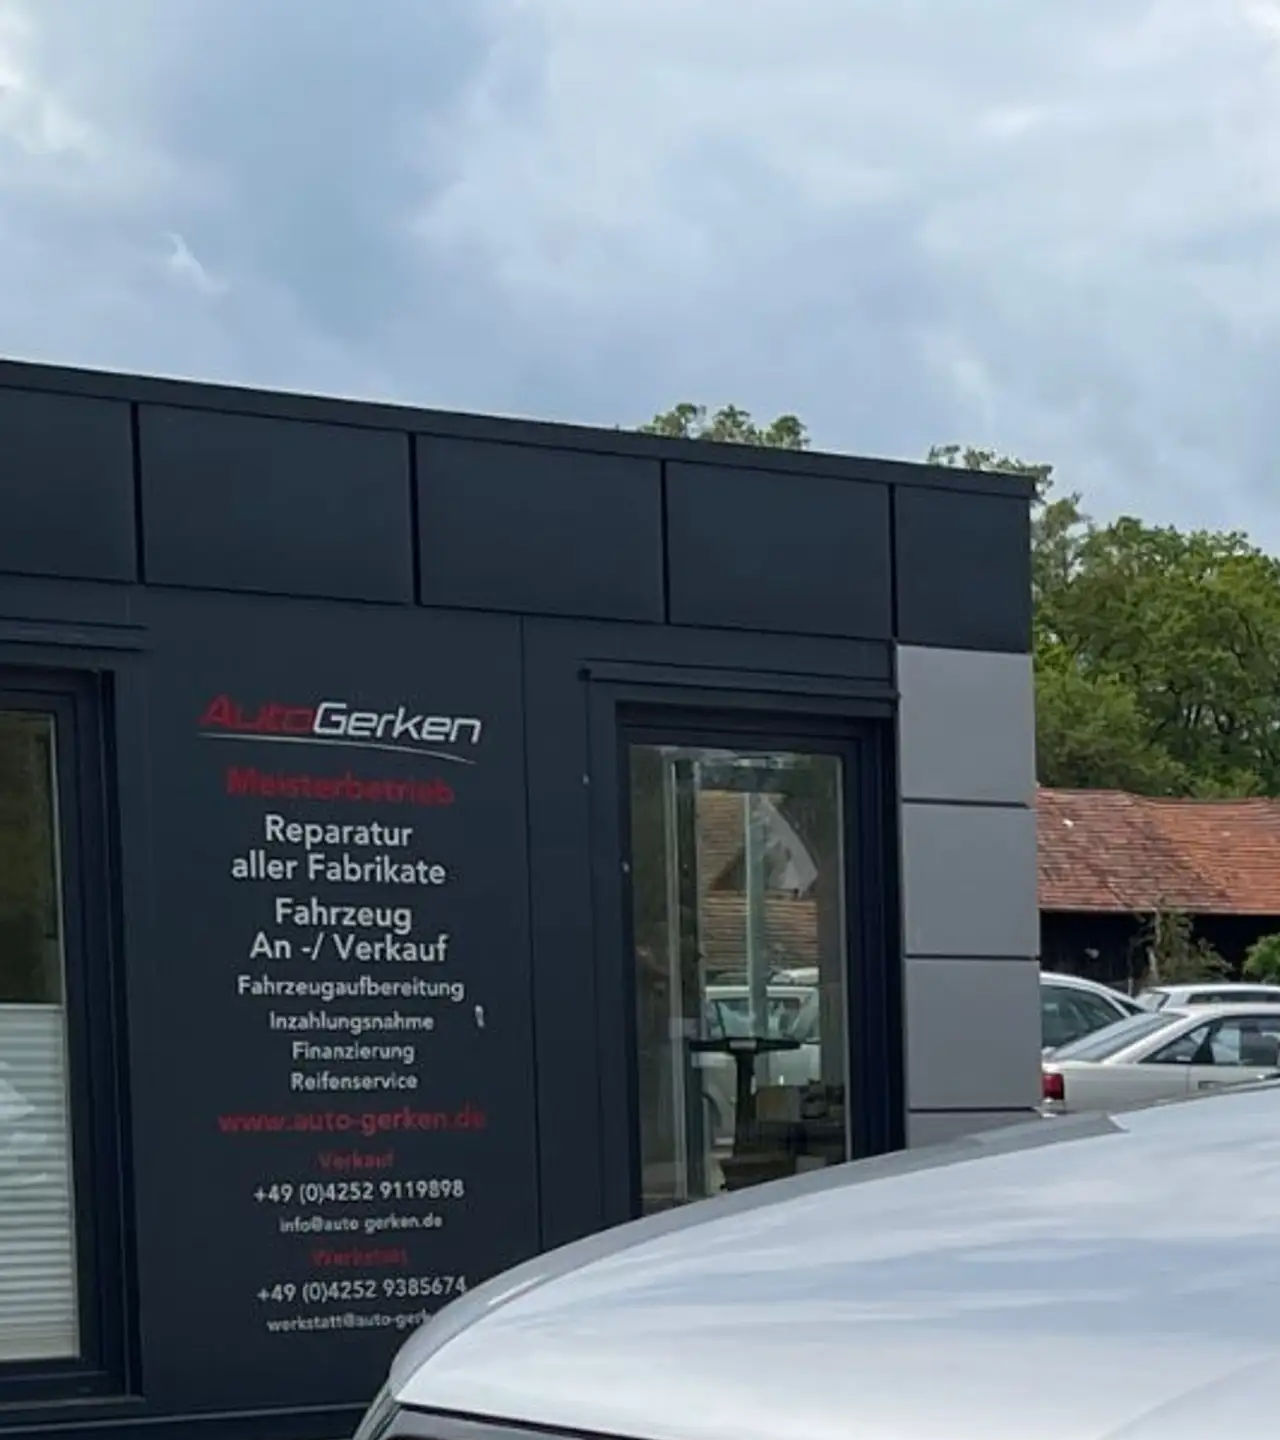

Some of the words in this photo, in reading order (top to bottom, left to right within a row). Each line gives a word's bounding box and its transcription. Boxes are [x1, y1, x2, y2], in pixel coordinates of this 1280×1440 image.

[198, 694, 482, 745] AutoGerken
[227, 767, 455, 805] Meisterbetrieb
[265, 814, 413, 850] Reparatur
[231, 850, 298, 881] aller
[307, 853, 446, 884] Fabrikate
[275, 897, 413, 935] Fahrzeug
[250, 931, 291, 960] An
[333, 933, 449, 962] Verkauf
[237, 975, 465, 1002] Fahrzeugaufbereitung
[269, 1011, 435, 1035] Inzahlungsnahme
[292, 1041, 416, 1064] Finanzierung
[290, 1071, 418, 1091] Reifenservice
[218, 1104, 488, 1137] www.auto-gerken.de
[253, 1183, 292, 1203] +49
[300, 1181, 374, 1206] (0)4252
[379, 1178, 465, 1200] 9119898
[280, 1212, 443, 1235] info@autogerken.de
[257, 1282, 297, 1303] +49
[303, 1280, 377, 1304] (0)4252
[383, 1275, 467, 1299] 9385674
